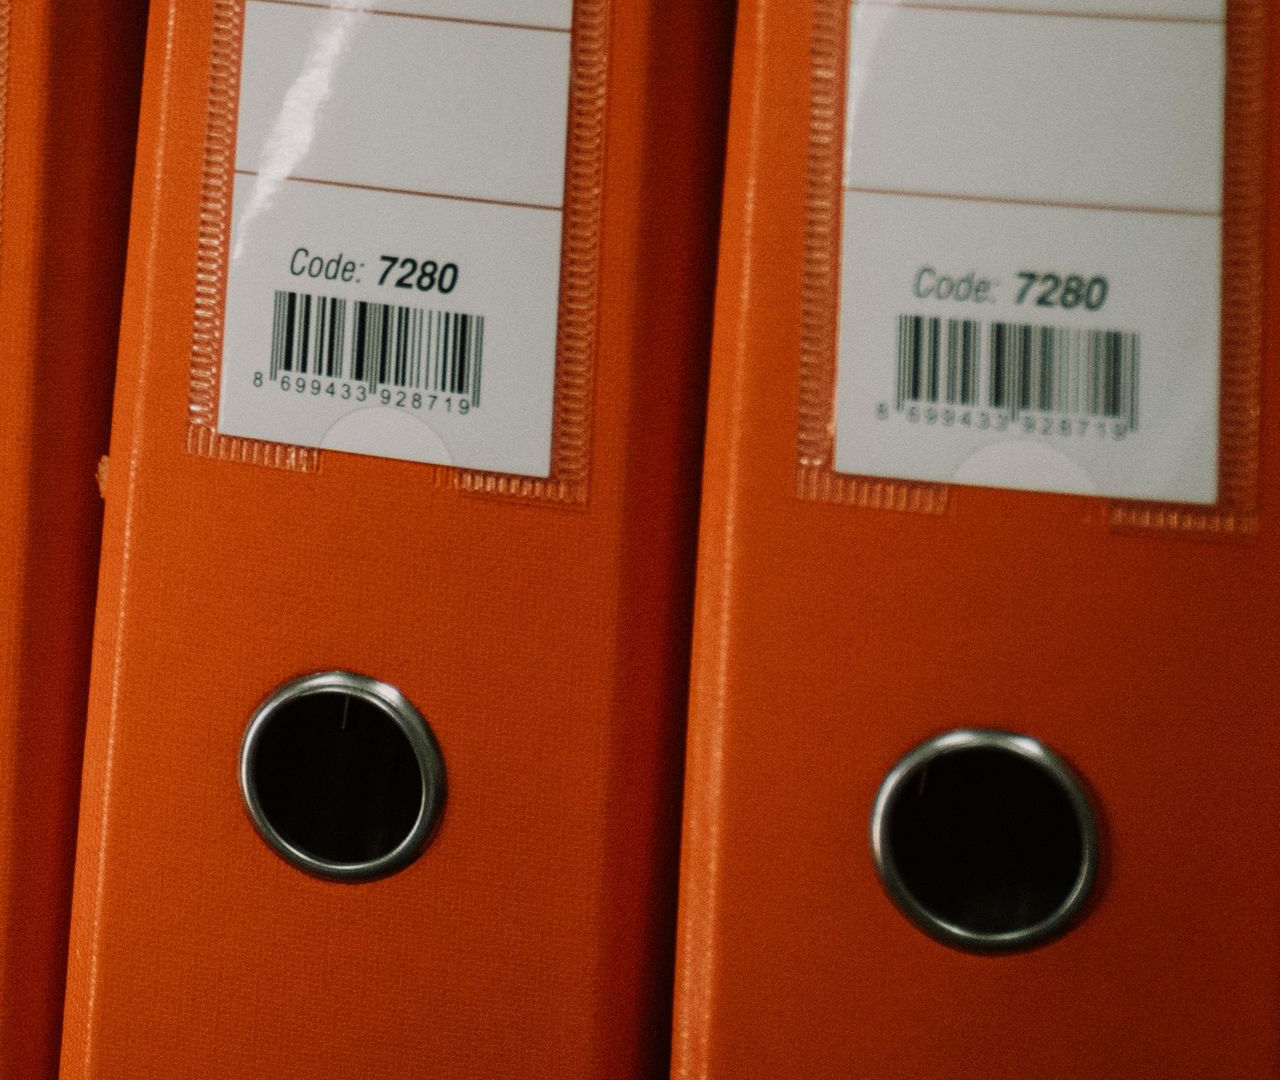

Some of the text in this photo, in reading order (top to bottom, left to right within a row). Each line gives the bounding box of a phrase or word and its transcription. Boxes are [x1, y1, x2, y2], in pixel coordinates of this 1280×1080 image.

[289, 247, 460, 294] Code: 7280
[912, 266, 1110, 312] Code: 7280
[252, 371, 471, 415] 8 699433 928719
